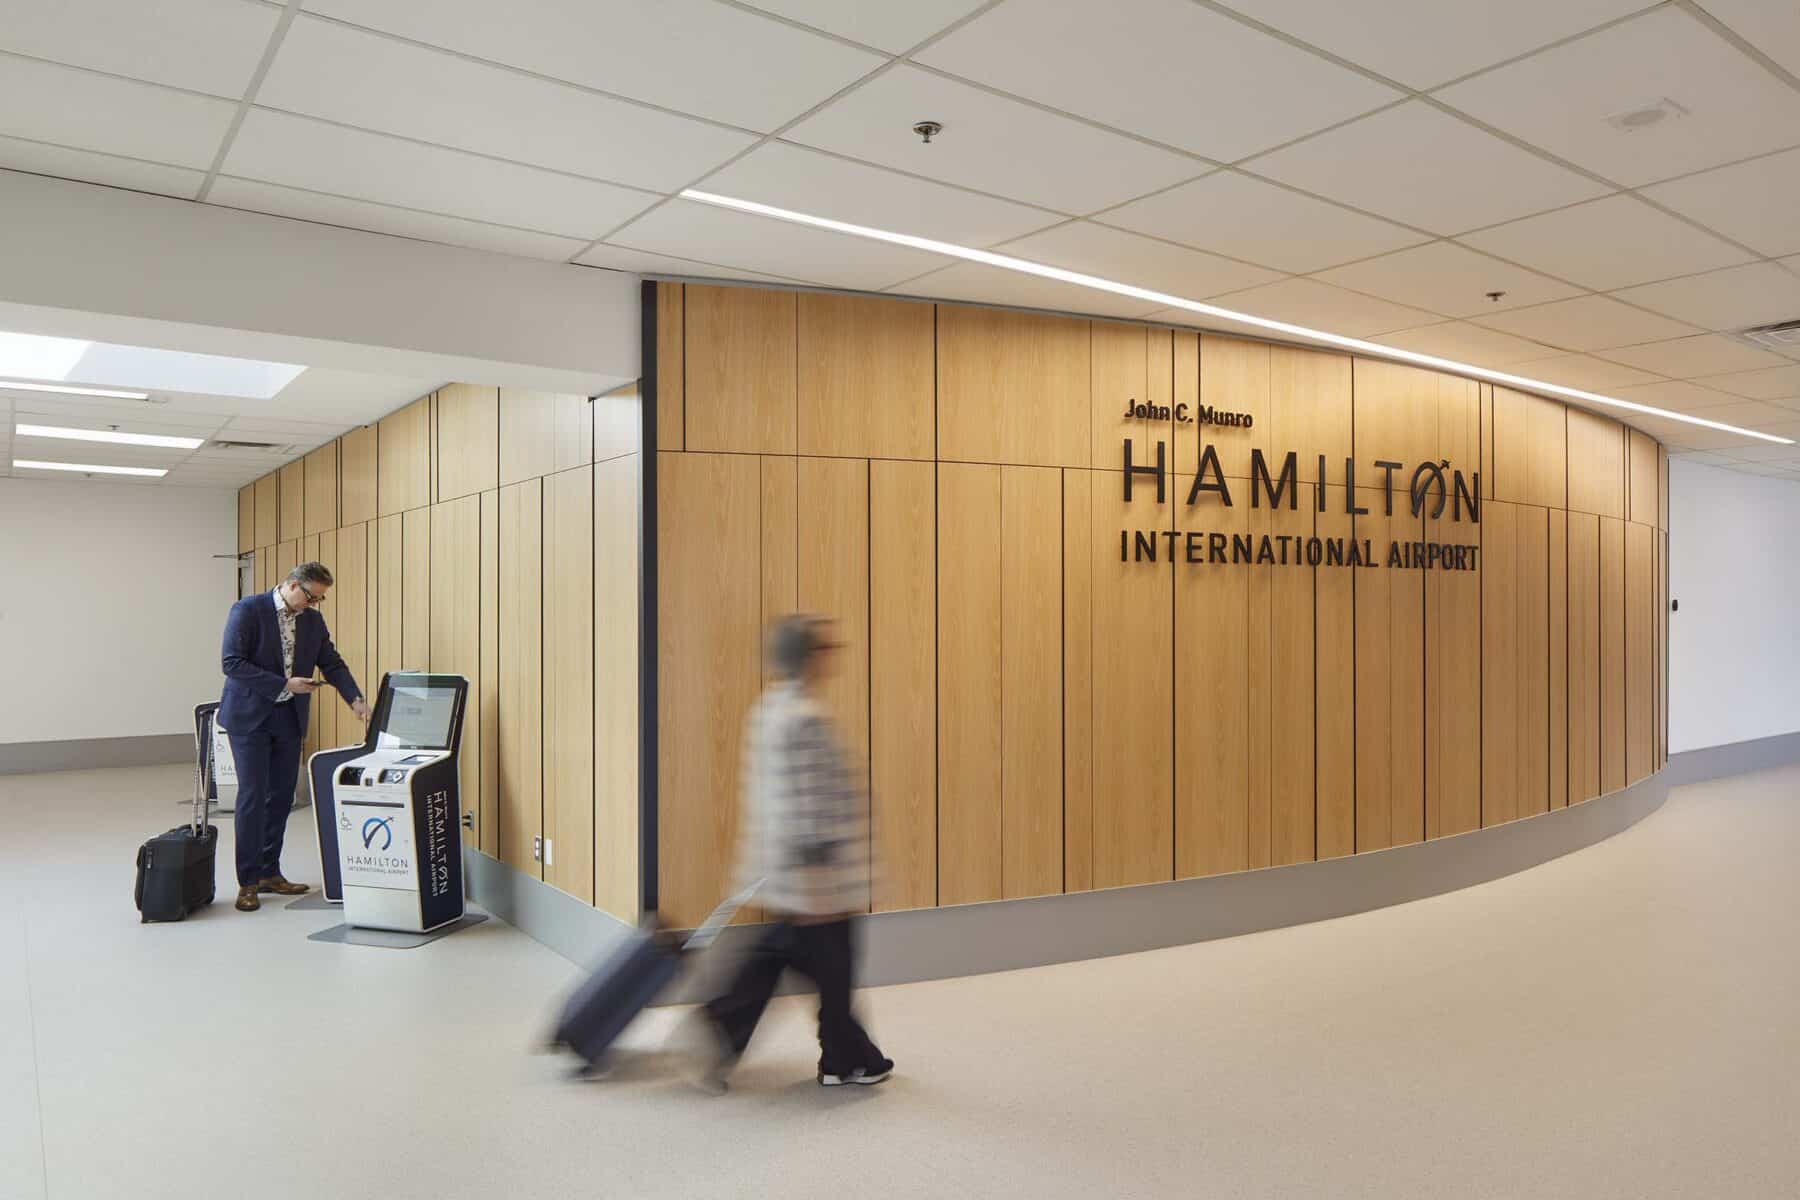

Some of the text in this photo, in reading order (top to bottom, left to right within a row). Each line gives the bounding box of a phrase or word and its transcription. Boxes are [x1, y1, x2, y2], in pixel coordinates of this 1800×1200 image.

[1124, 399, 1254, 428] John C. Munro
[1123, 438, 1480, 523] HAMILTON
[1120, 530, 1479, 571] INTERNATIONAL AIRPORT
[347, 856, 408, 868] HAMILTON
[434, 791, 448, 894] HAMILTON
